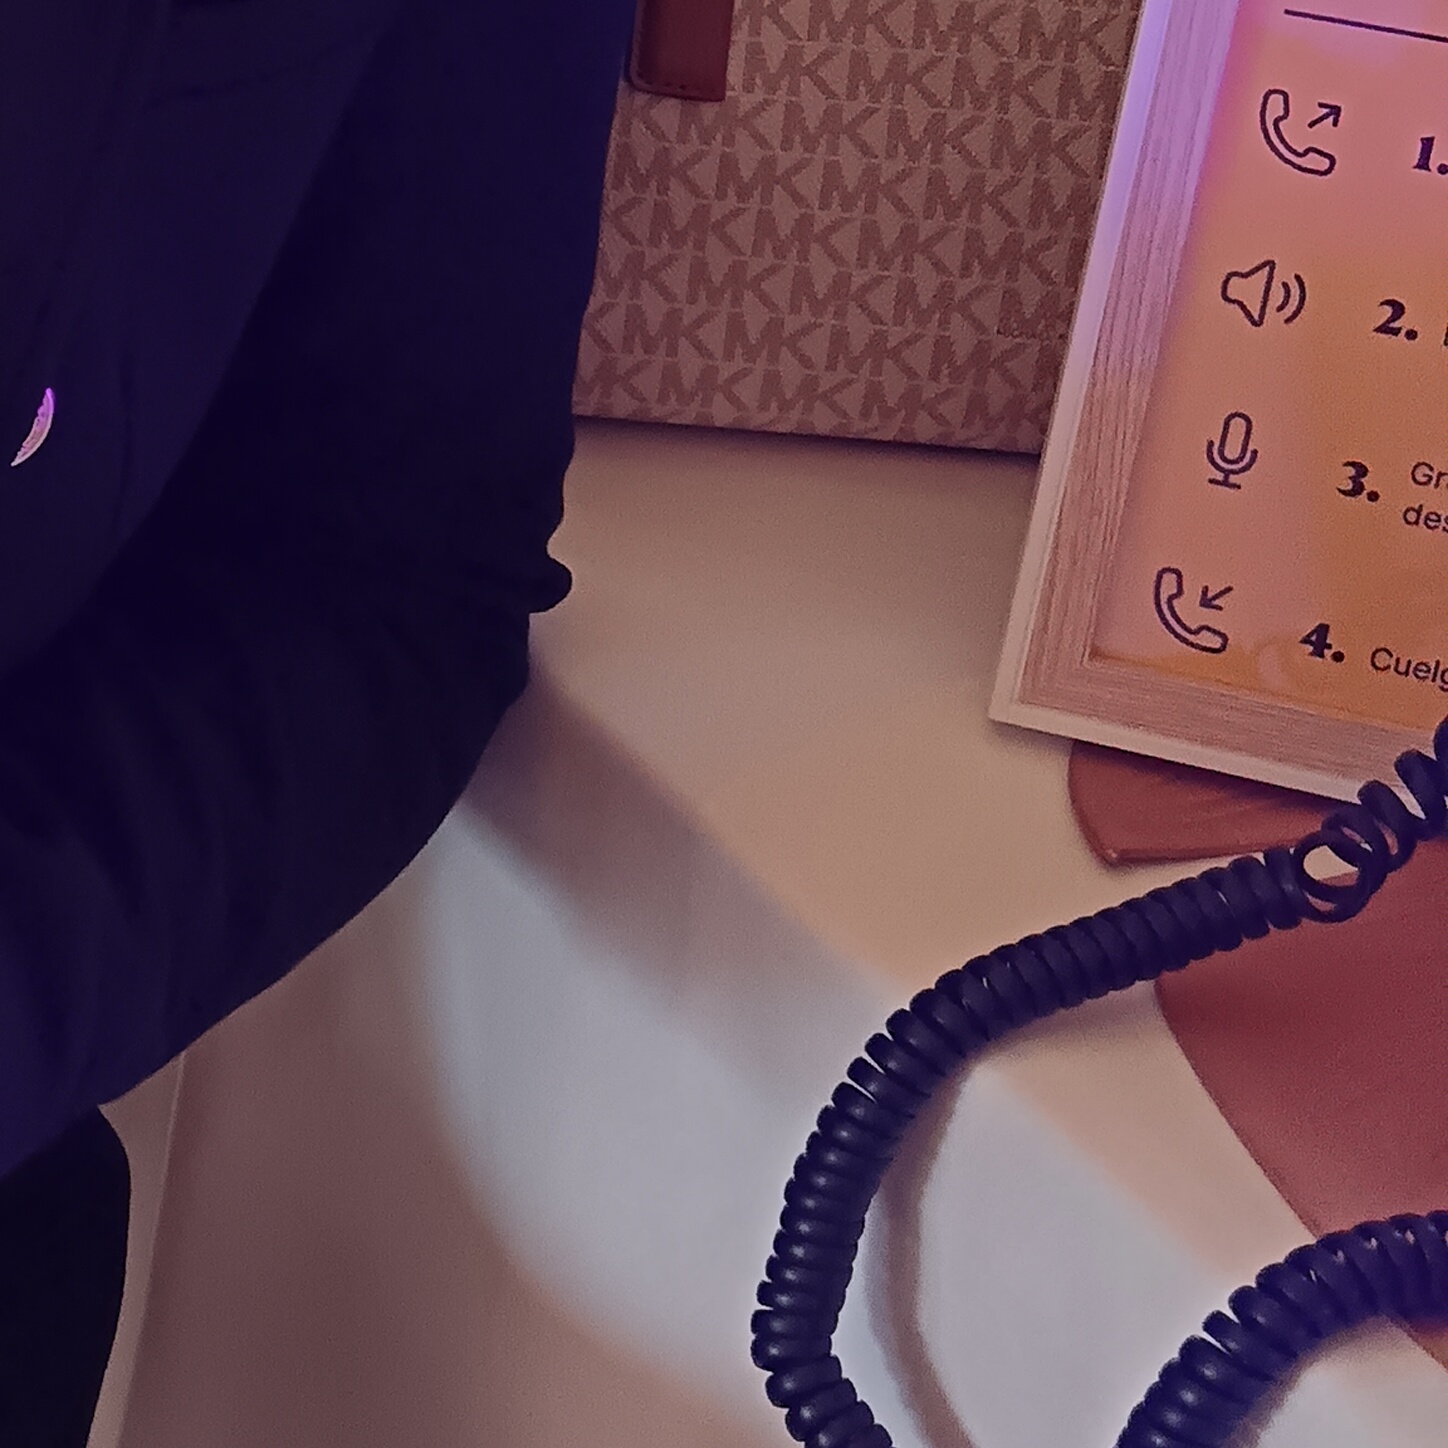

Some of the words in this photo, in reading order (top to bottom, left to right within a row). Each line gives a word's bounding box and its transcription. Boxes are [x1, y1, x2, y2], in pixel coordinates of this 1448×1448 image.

[1412, 136, 1448, 176] 1.
[1372, 298, 1418, 342] 2.
[1336, 460, 1381, 503] 3.
[1299, 622, 1345, 664] 4.
